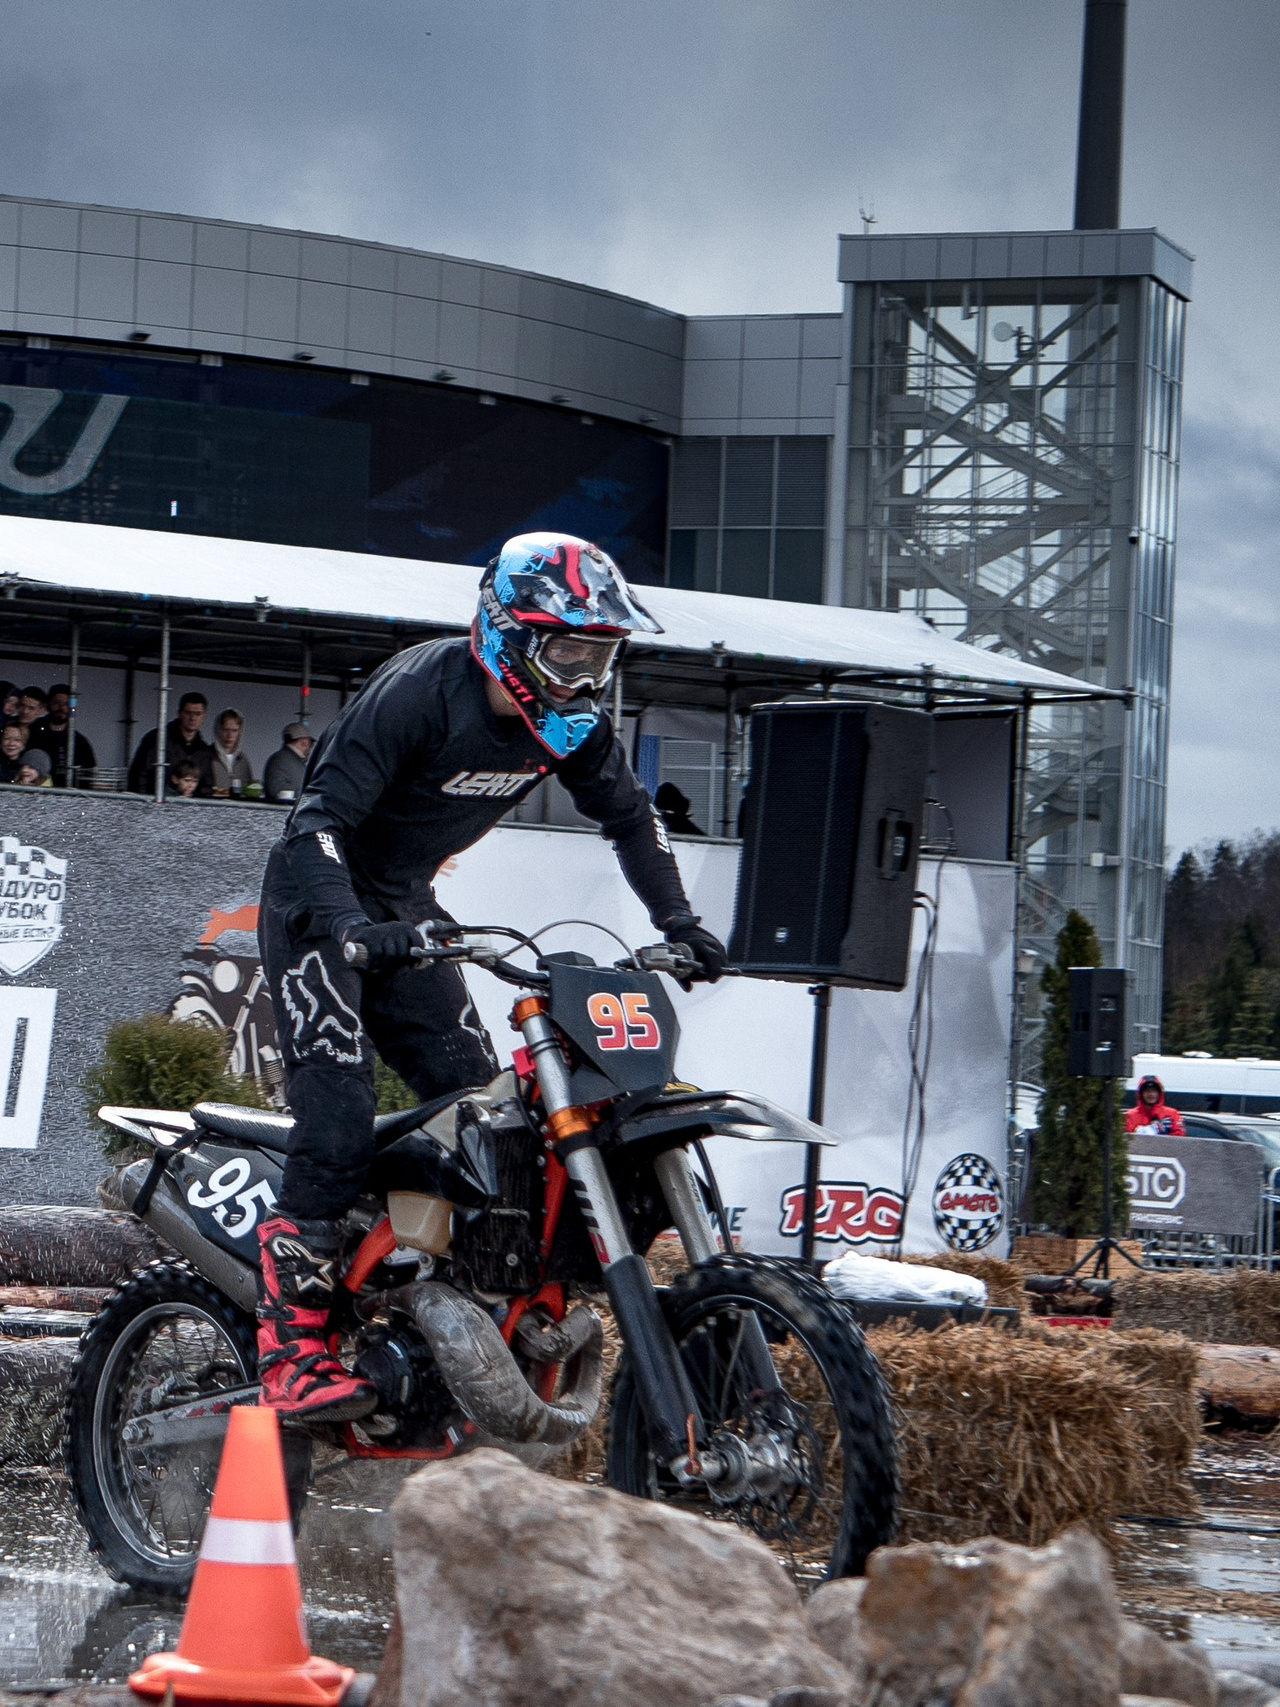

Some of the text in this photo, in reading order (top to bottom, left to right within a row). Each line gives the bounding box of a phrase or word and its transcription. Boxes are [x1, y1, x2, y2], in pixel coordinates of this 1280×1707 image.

[441, 771, 540, 797] LEATT
[587, 992, 661, 1051] 95
[187, 1157, 278, 1239] 95
